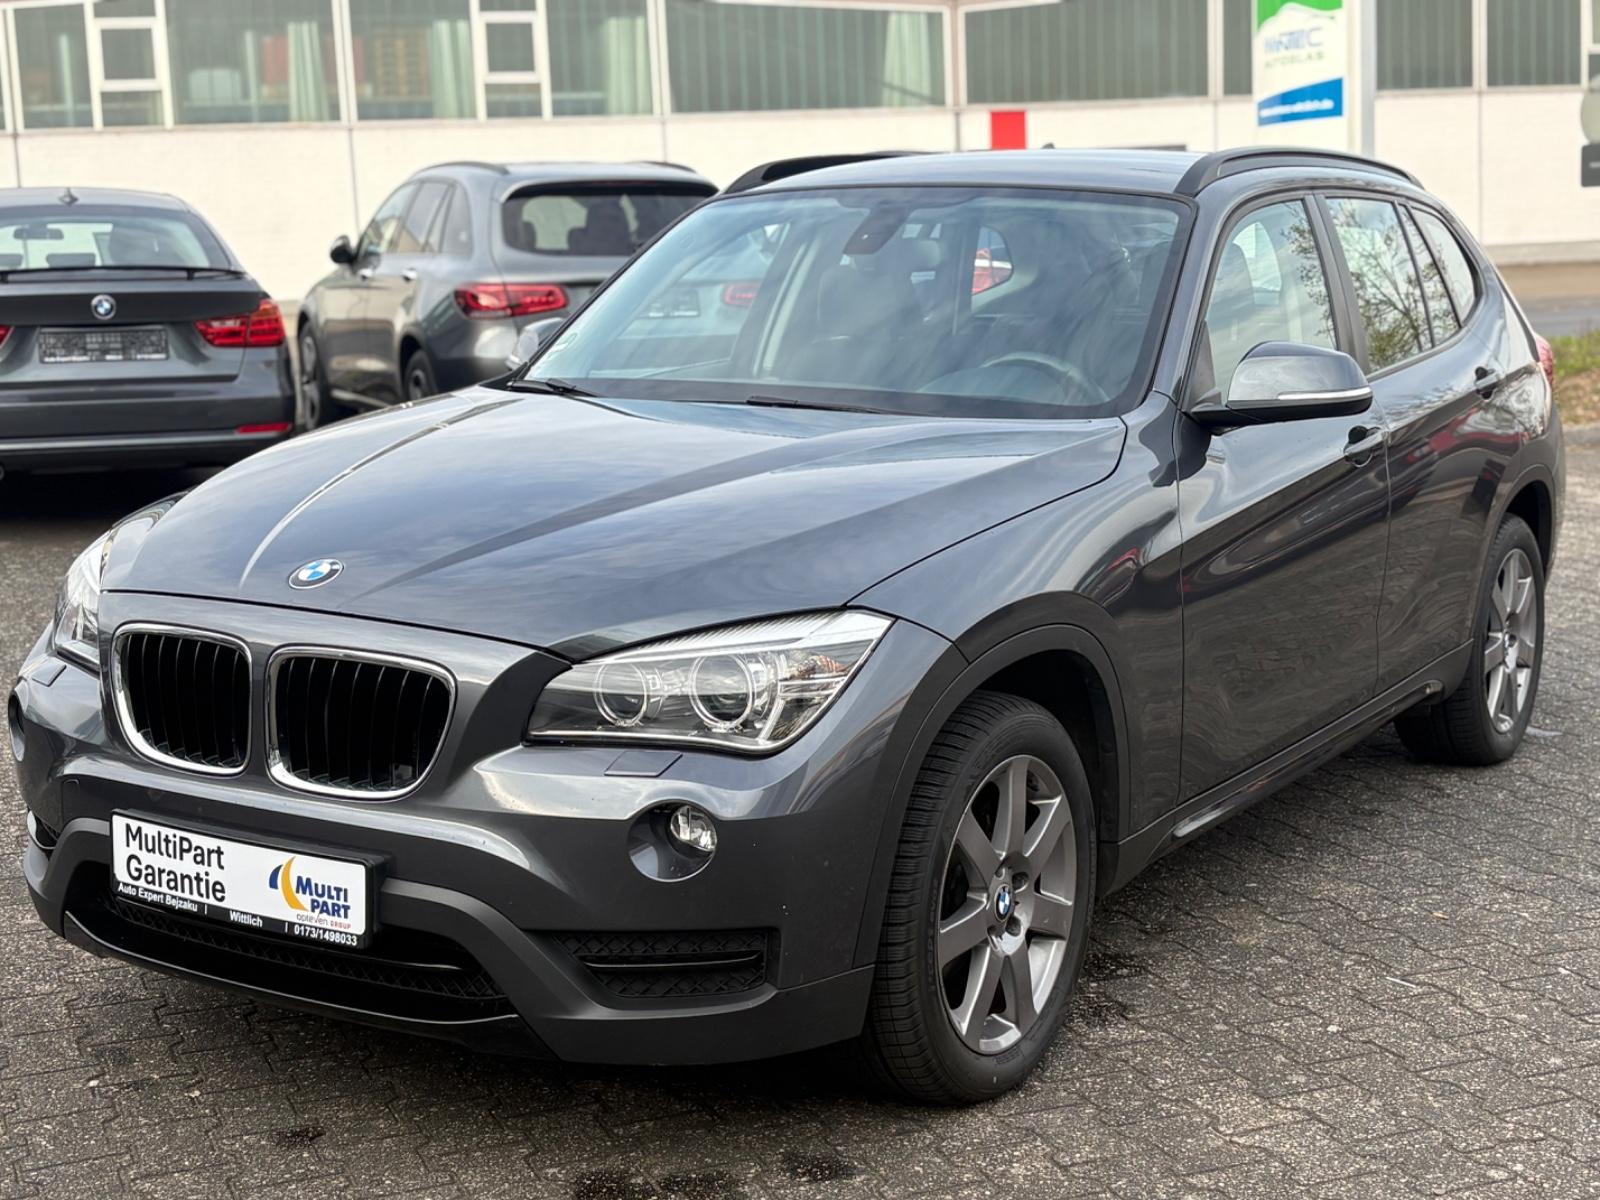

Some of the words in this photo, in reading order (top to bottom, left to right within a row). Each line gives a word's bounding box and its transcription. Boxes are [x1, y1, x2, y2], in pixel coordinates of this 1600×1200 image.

[125, 822, 225, 870] MultiPart
[126, 853, 226, 903] Garantie
[295, 875, 348, 903] MULTI
[117, 882, 137, 896] Auto
[138, 887, 165, 904] Expert
[165, 894, 198, 912] Bejzaku
[310, 898, 351, 920] PART
[229, 909, 263, 928] Wittlich
[294, 923, 358, 946] 0173/1498033
